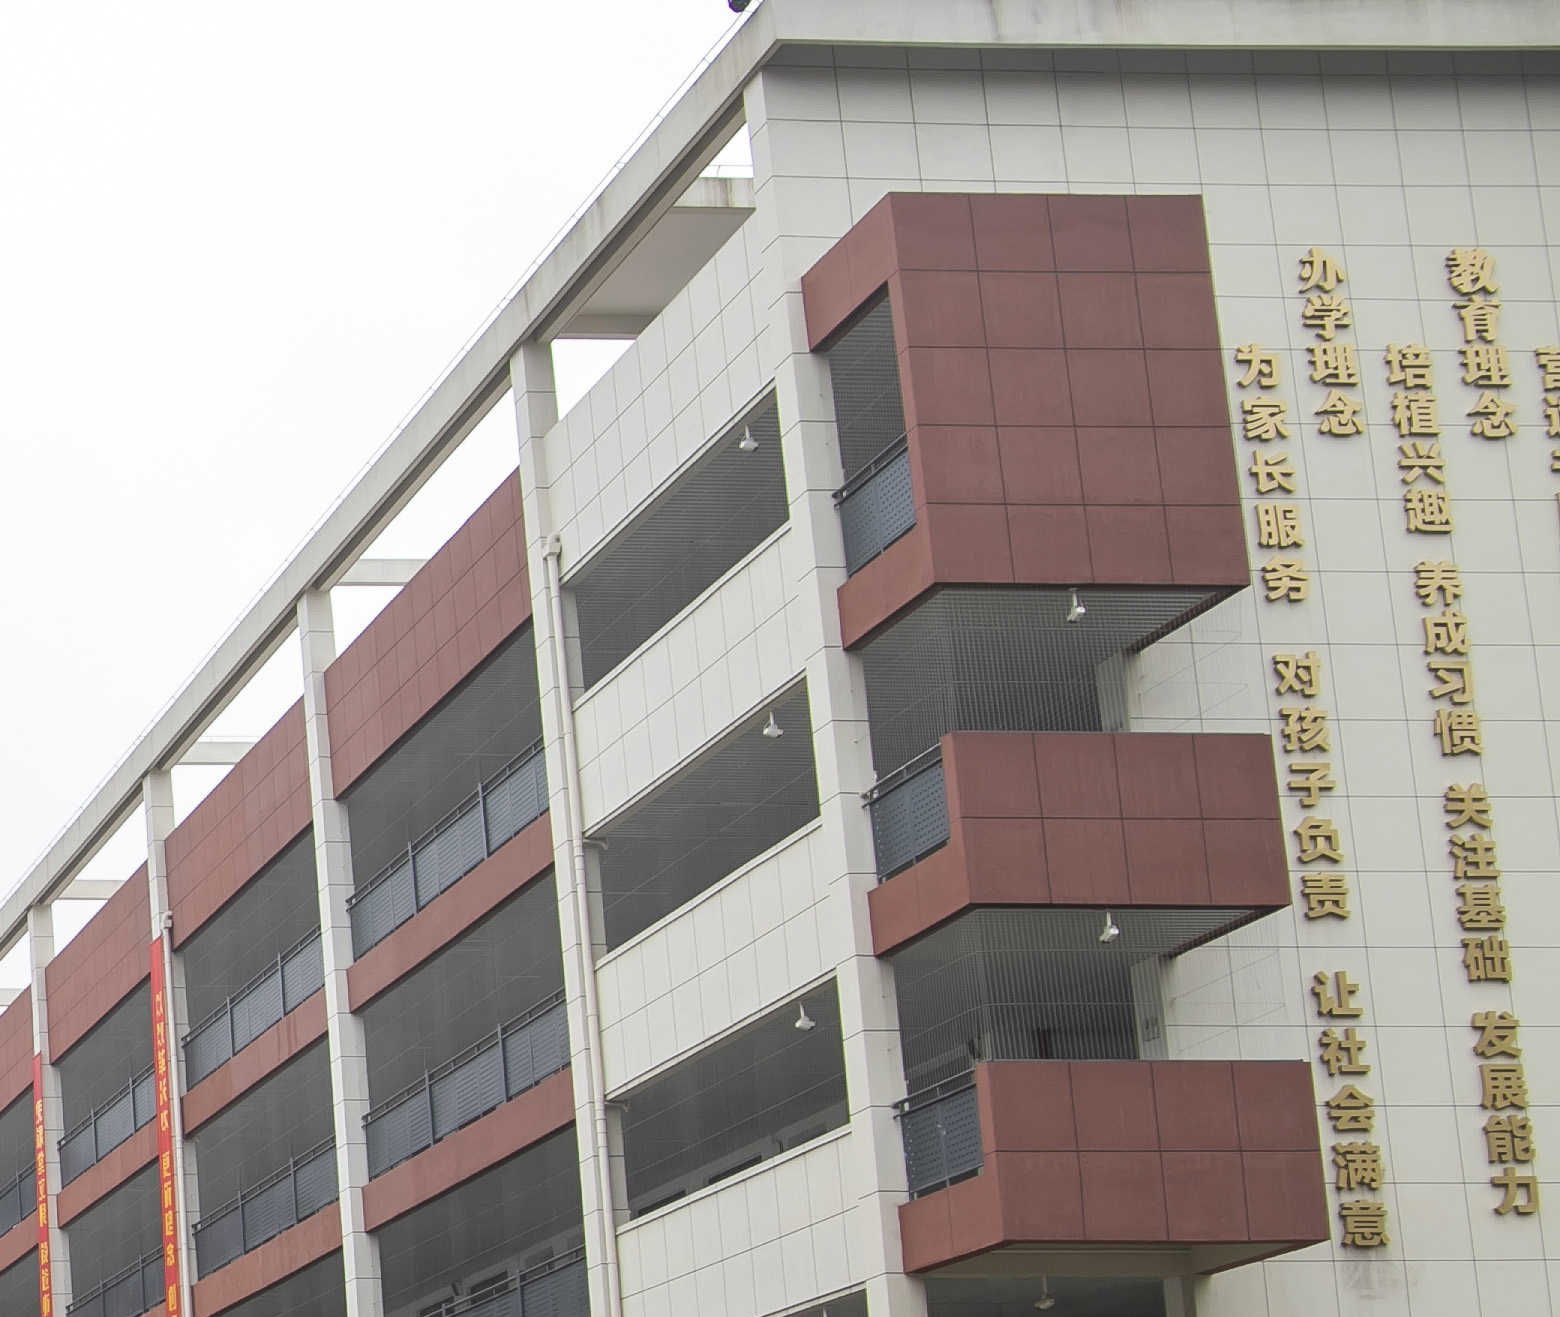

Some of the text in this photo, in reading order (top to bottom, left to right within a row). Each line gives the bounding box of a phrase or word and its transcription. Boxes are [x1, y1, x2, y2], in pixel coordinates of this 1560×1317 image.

[1299, 247, 1365, 436] 办学理念
[1447, 248, 1518, 438] 教育理念
[1235, 344, 1392, 1247] 为家长服务 对孩子负责 让社会满意
[1385, 343, 1541, 1217] 培植兴趣 养成习惯 关注基础 发展能力
